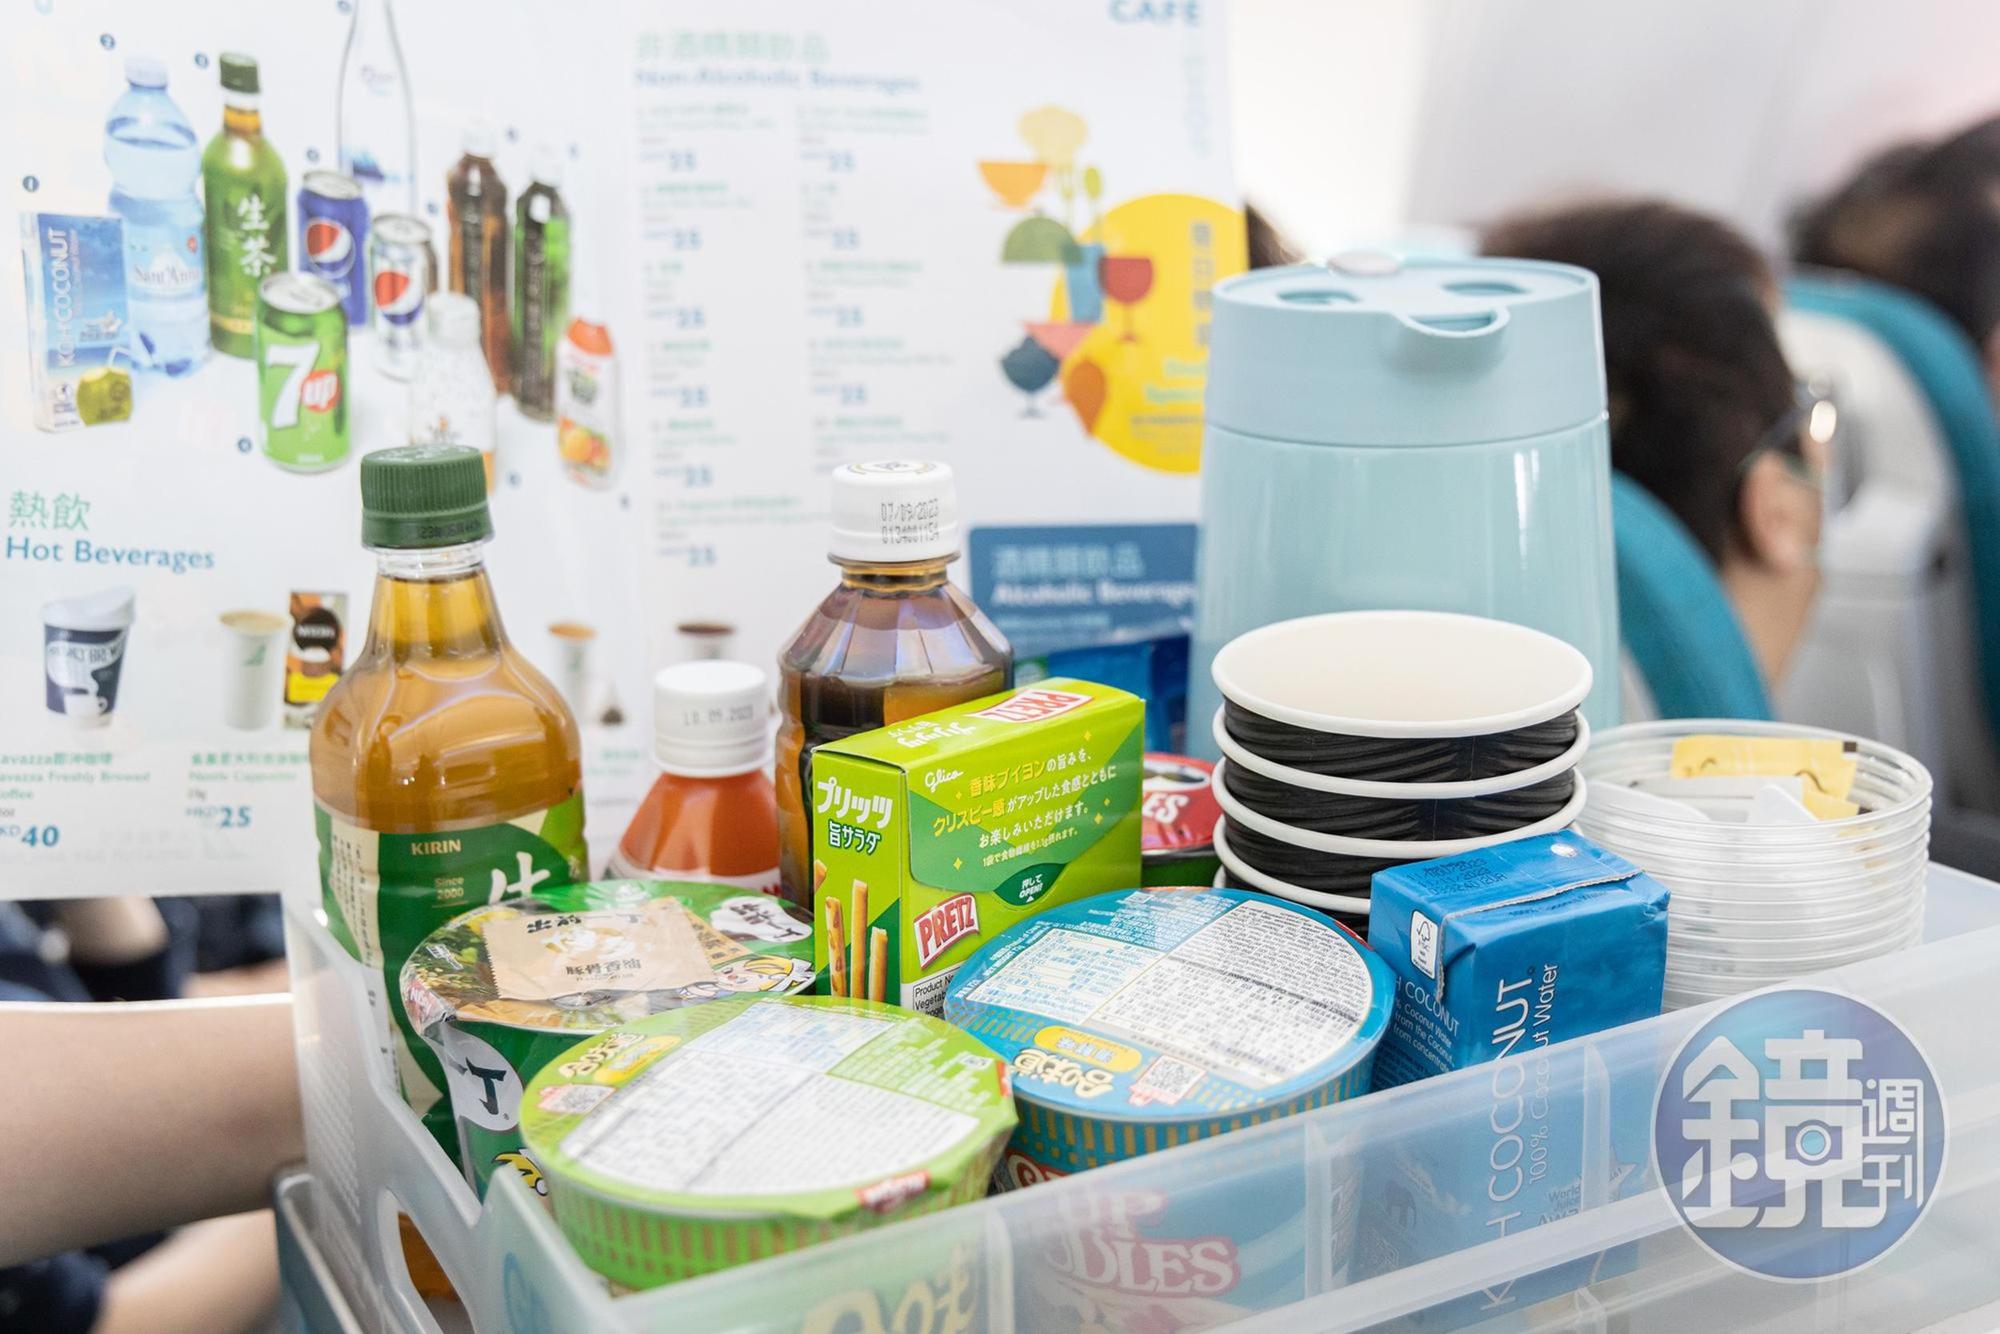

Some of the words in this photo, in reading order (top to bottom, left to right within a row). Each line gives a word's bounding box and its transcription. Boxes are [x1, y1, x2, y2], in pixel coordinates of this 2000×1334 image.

[9, 490, 90, 530] 熱飲
[6, 535, 63, 562] Hot
[75, 539, 214, 574] Beverages
[0, 772, 43, 783] avazza
[924, 767, 964, 793] Glico
[219, 806, 252, 828] 25
[817, 776, 893, 829] プリッツ
[1142, 791, 1190, 825] ES
[21, 825, 60, 847] 40
[411, 839, 462, 856] KIRIN
[828, 821, 881, 855] 旨サラダ
[434, 877, 464, 888] Since
[436, 887, 464, 900] 2000
[918, 896, 975, 960] PRETZ
[915, 979, 943, 997] Product
[915, 990, 946, 1011] Vegetab
[1533, 963, 1559, 1025] Water
[1405, 981, 1460, 1037] COCONUT
[1488, 978, 1533, 1202] COCONUT
[1529, 1126, 1549, 1184] 100%
[1480, 1211, 1523, 1310] KH
